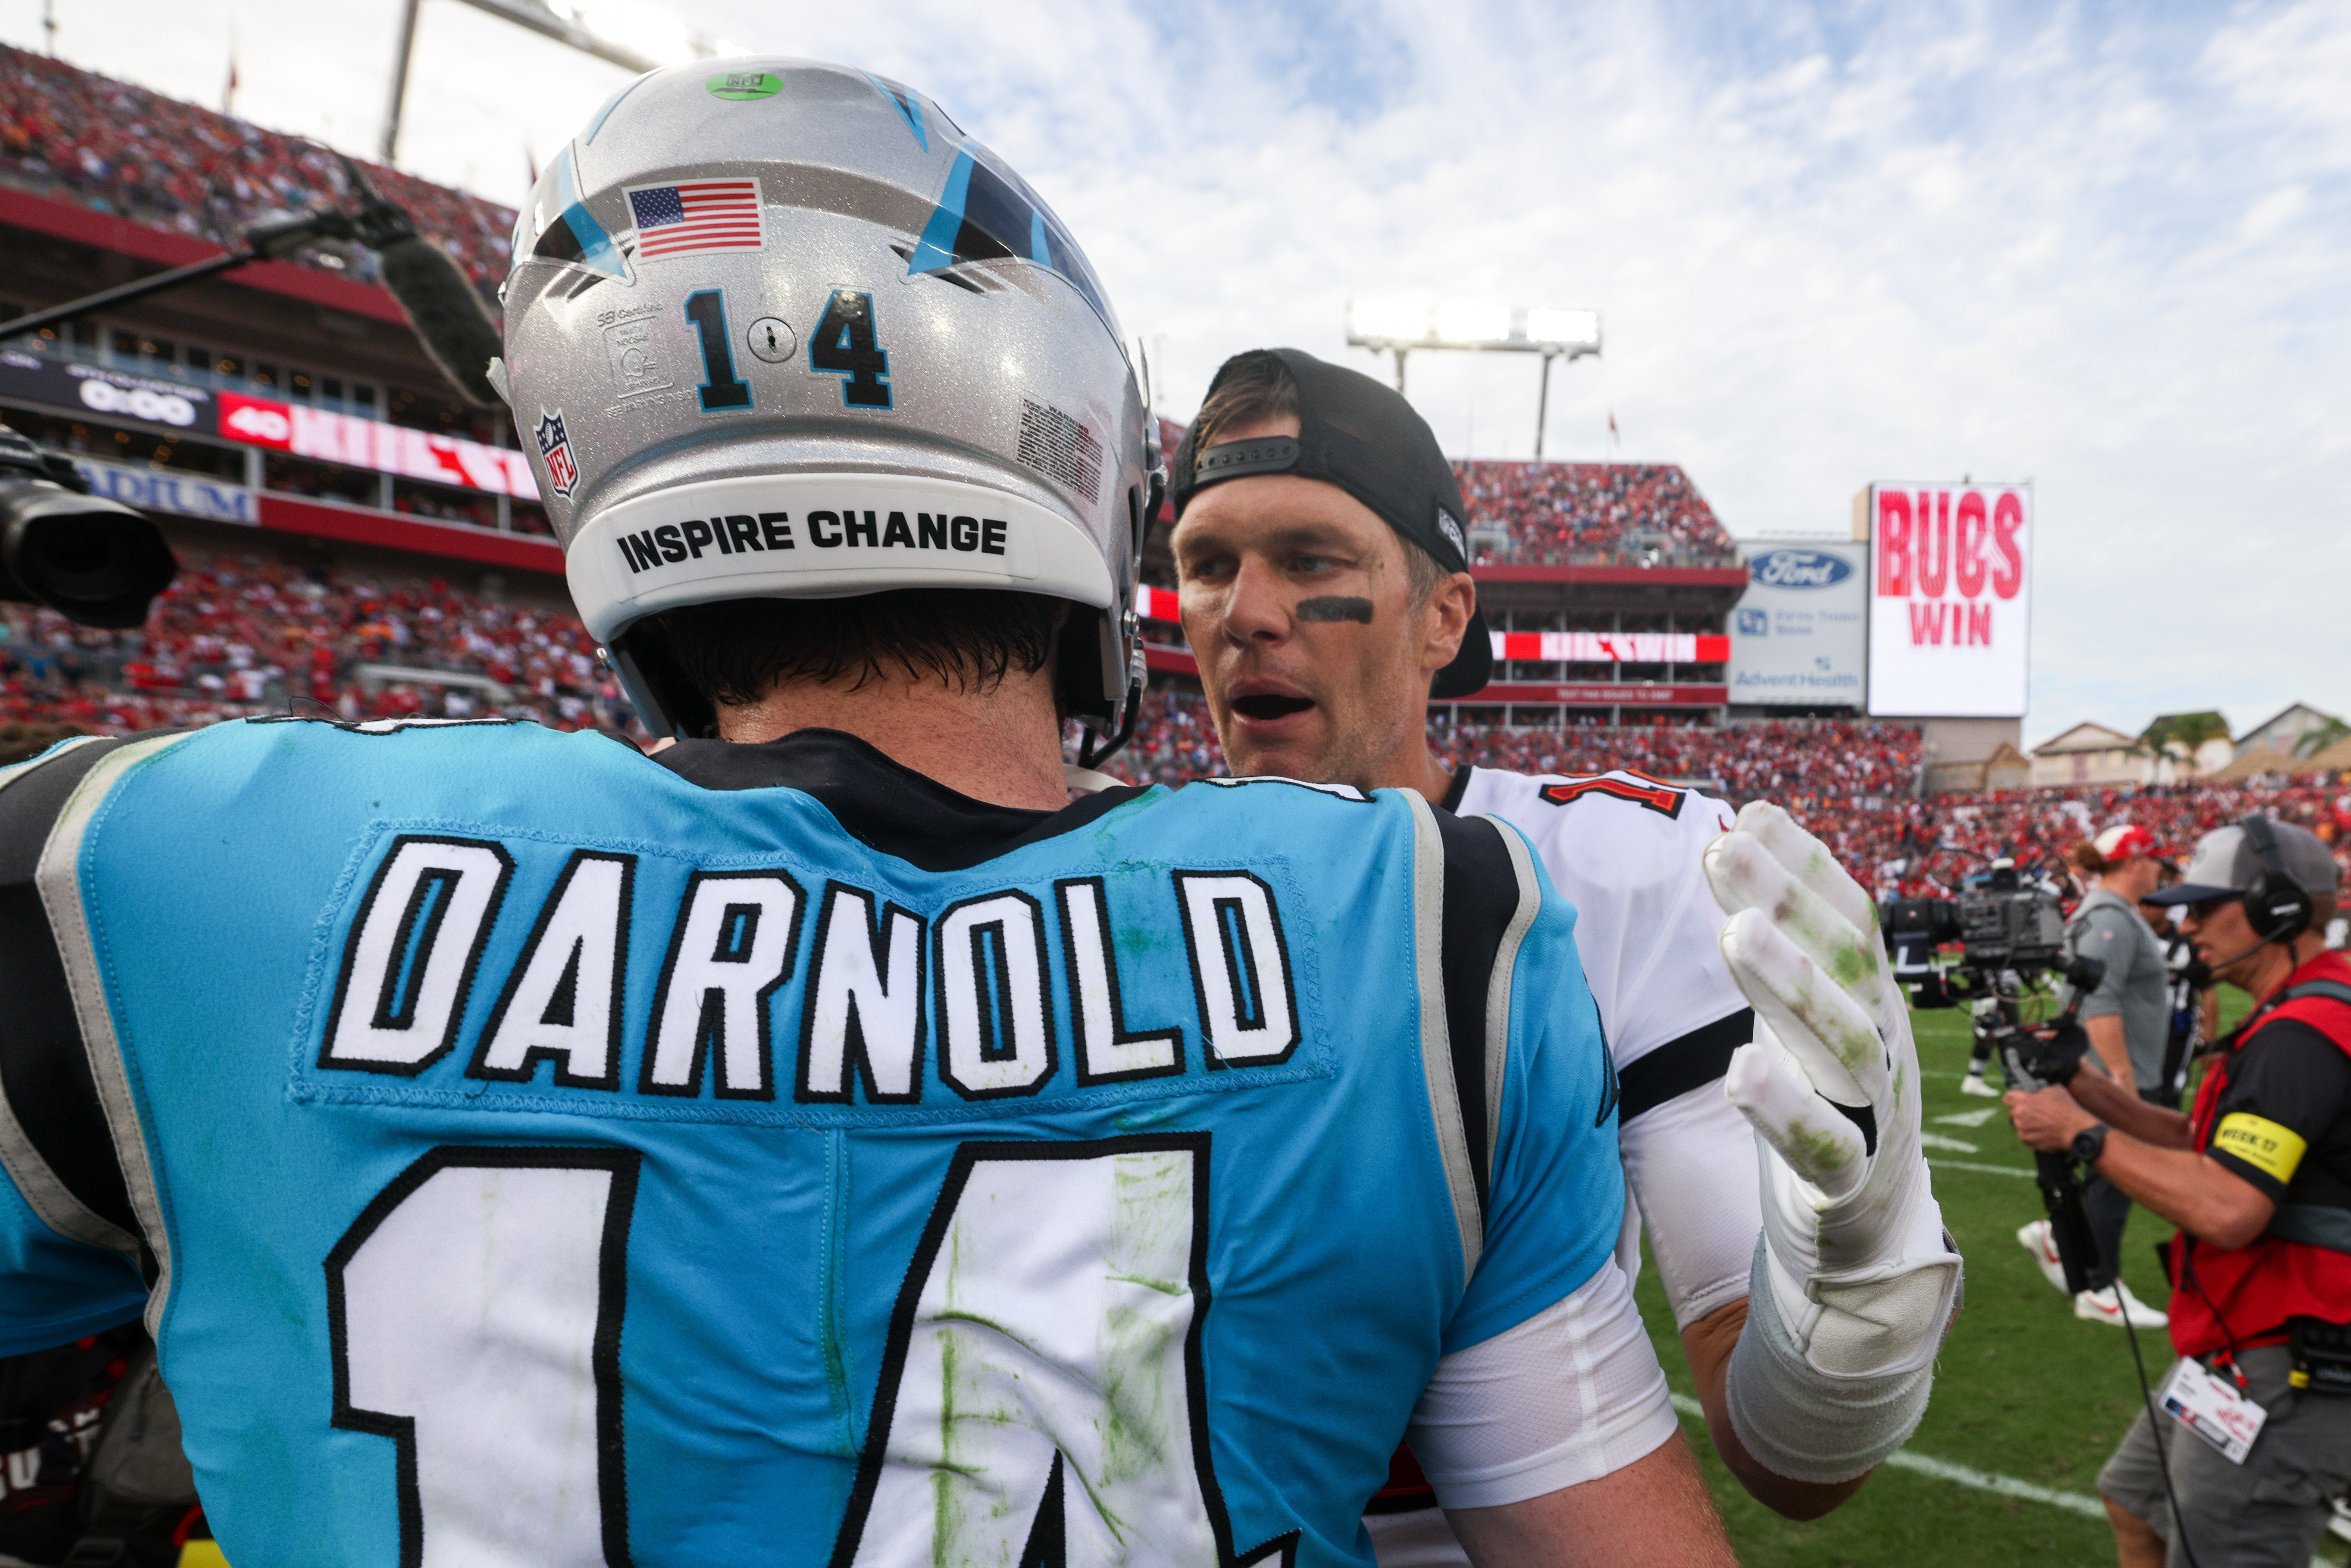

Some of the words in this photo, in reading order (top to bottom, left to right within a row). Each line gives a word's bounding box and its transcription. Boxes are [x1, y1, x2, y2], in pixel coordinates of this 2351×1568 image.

[1048, 403, 1089, 435] WARNING
[546, 447, 575, 488] NFL
[617, 512, 795, 574] INSPIRE
[806, 510, 1007, 555] CHANGE
[1762, 552, 1835, 583] Ford
[1878, 489, 2022, 599] BUCS
[1909, 603, 1991, 645] WIN
[316, 834, 1302, 1105] DARNOLD
[322, 1130, 1302, 1568] 14
